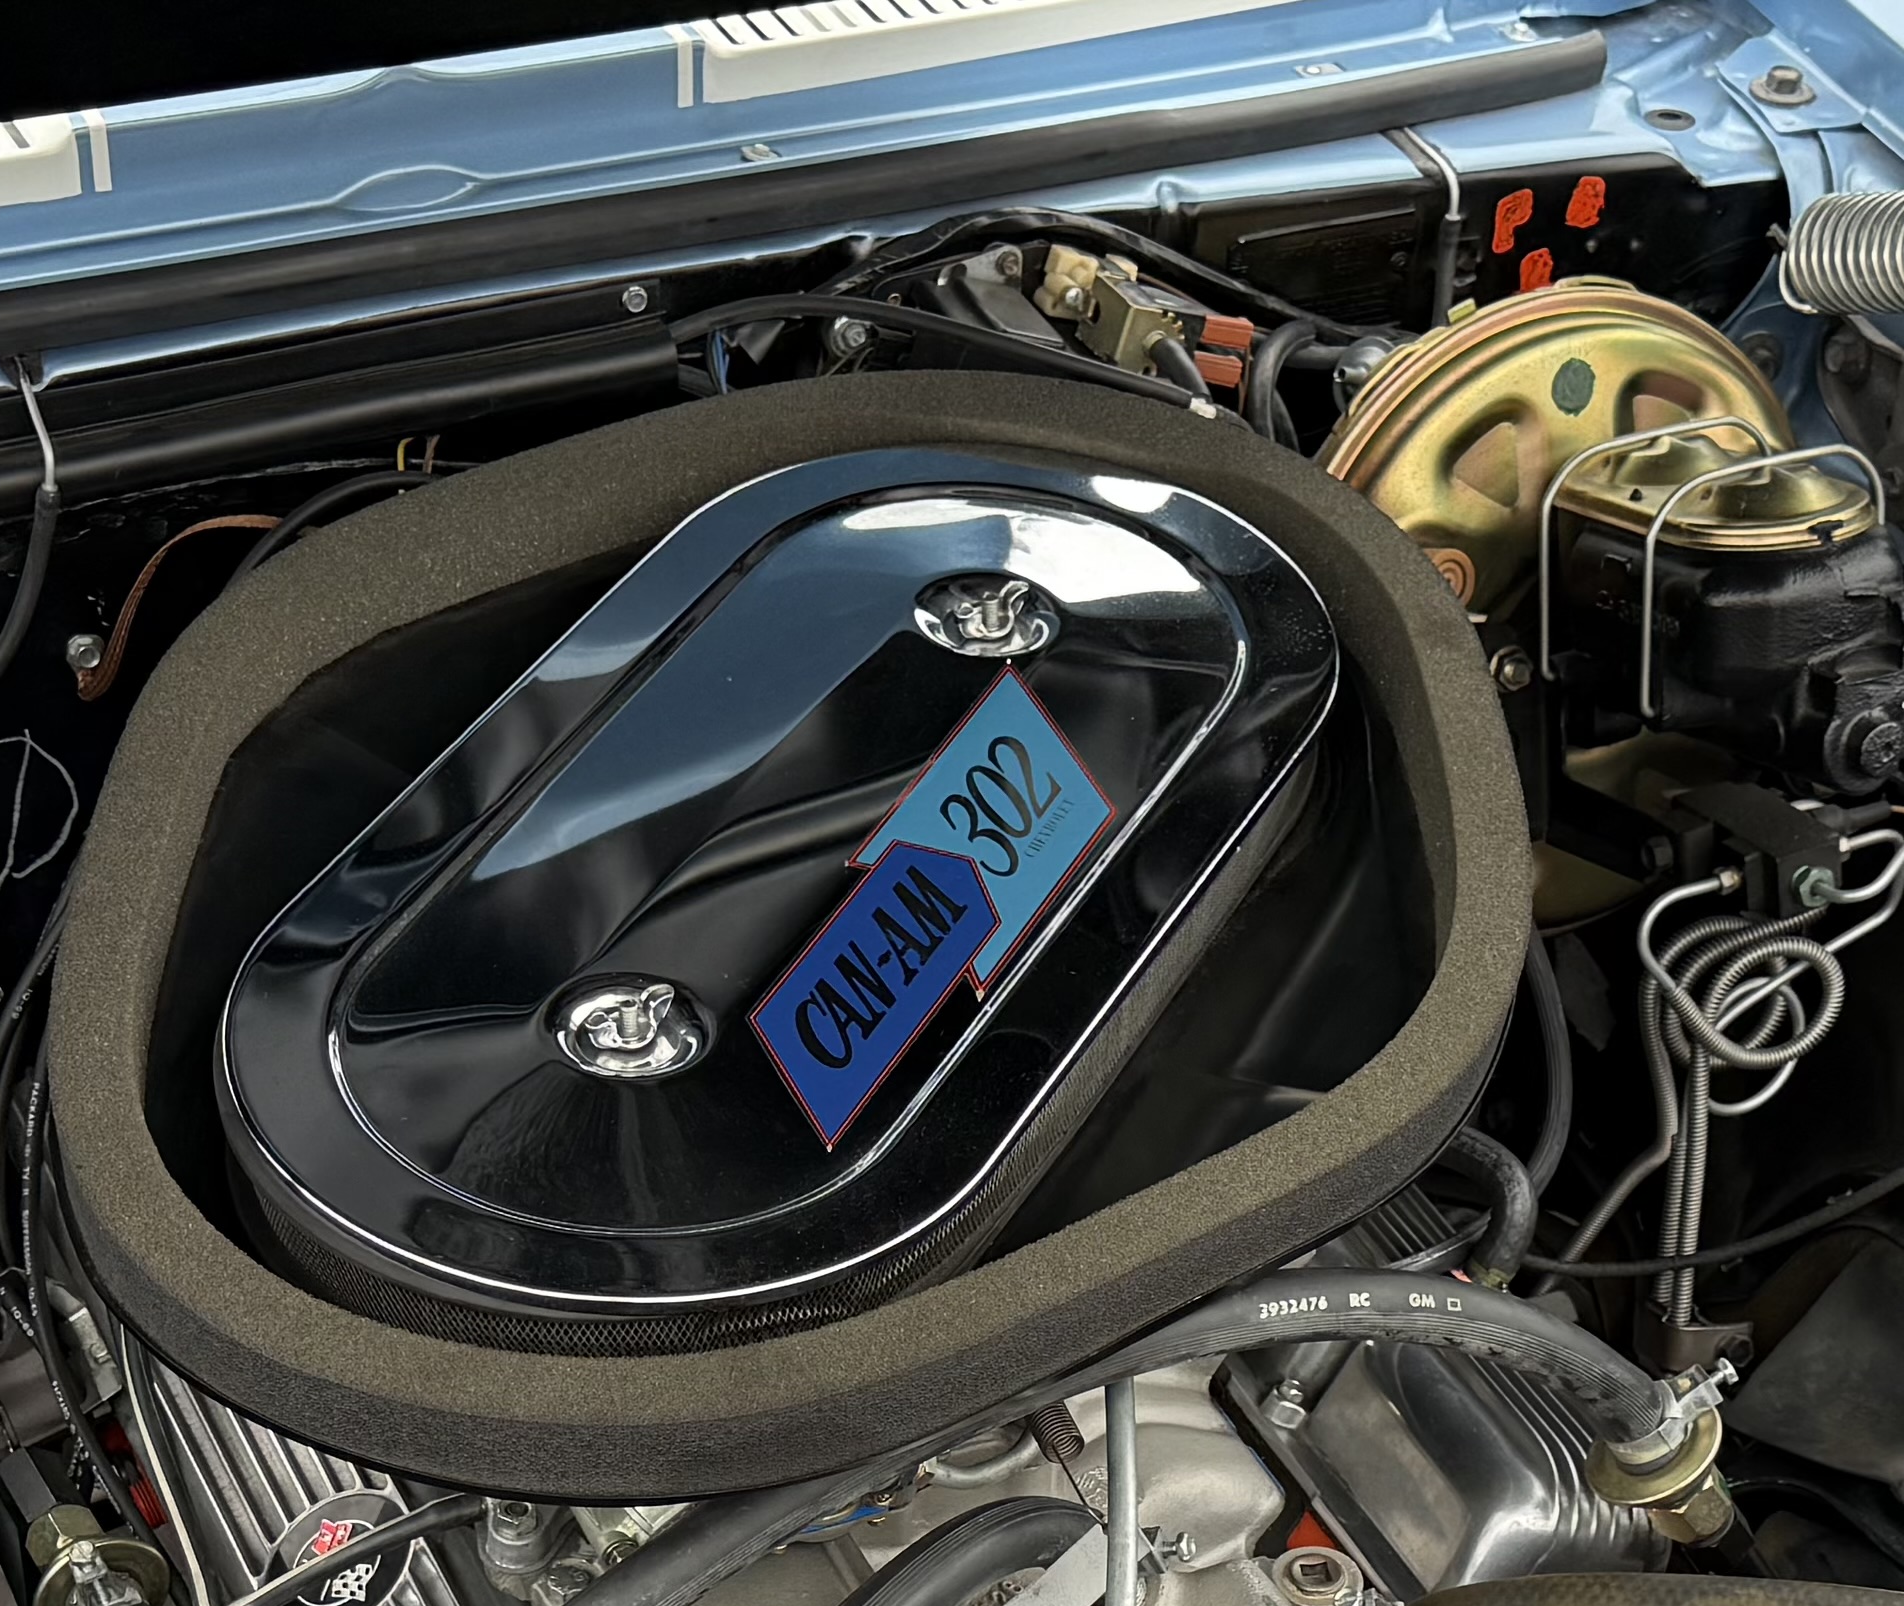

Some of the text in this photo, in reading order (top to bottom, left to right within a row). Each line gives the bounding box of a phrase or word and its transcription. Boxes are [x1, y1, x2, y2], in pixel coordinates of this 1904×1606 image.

[939, 736, 1061, 877] 302
[1024, 799, 1078, 859] CHEVROLET
[795, 865, 968, 1069] CAN-AM
[26, 1081, 40, 1137] PACKARD
[21, 1165, 30, 1180] TV
[1258, 1293, 1436, 1319] 3932476 RC GM
